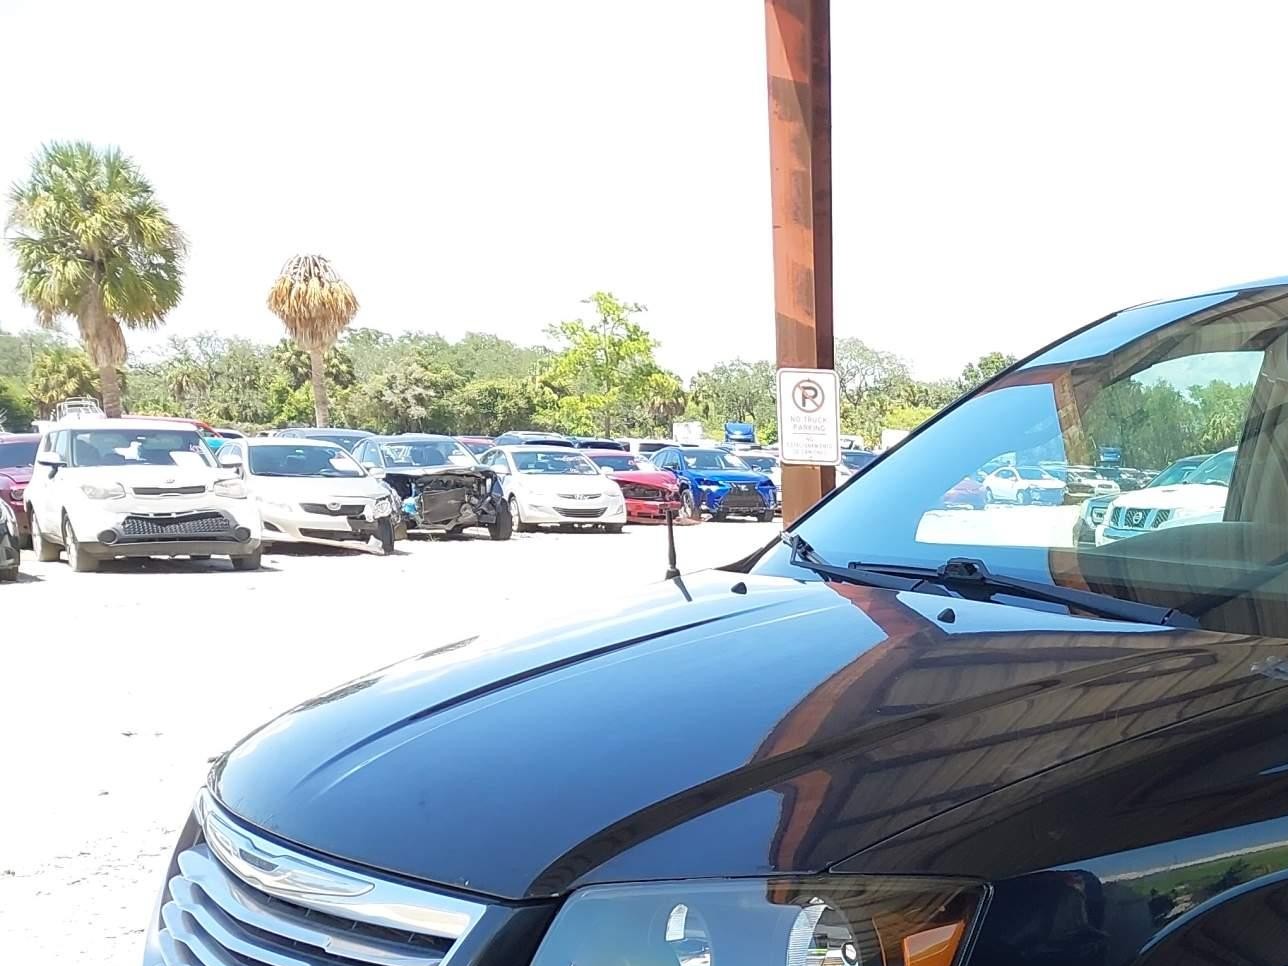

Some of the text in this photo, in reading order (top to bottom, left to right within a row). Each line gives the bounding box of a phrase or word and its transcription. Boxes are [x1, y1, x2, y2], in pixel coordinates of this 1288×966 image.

[790, 415, 827, 424] NO TRUCK
[793, 424, 826, 432] PARKING
